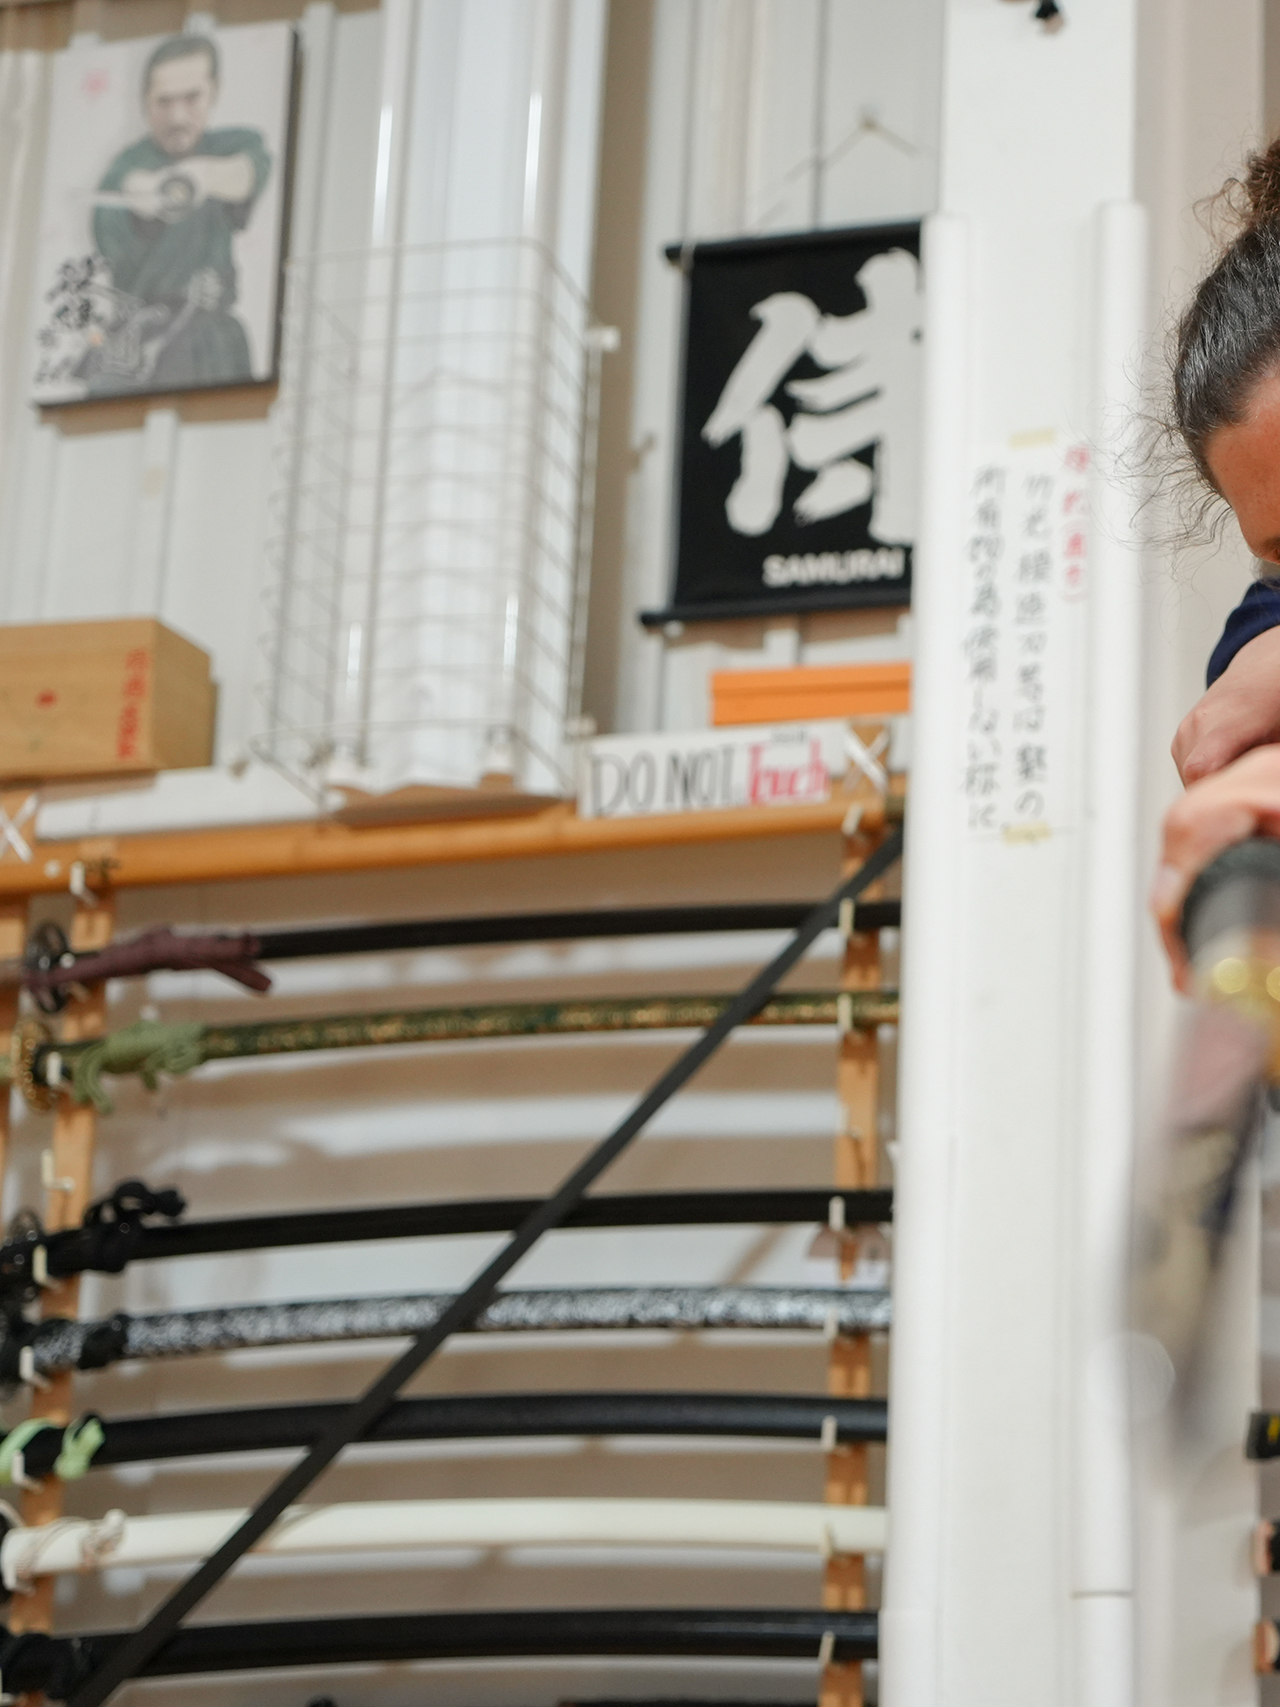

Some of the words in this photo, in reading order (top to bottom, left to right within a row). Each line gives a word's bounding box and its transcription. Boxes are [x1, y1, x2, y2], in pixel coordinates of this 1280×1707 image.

[763, 548, 905, 588] SAMURAI
[591, 750, 656, 816] DO
[664, 743, 738, 806] NOT
